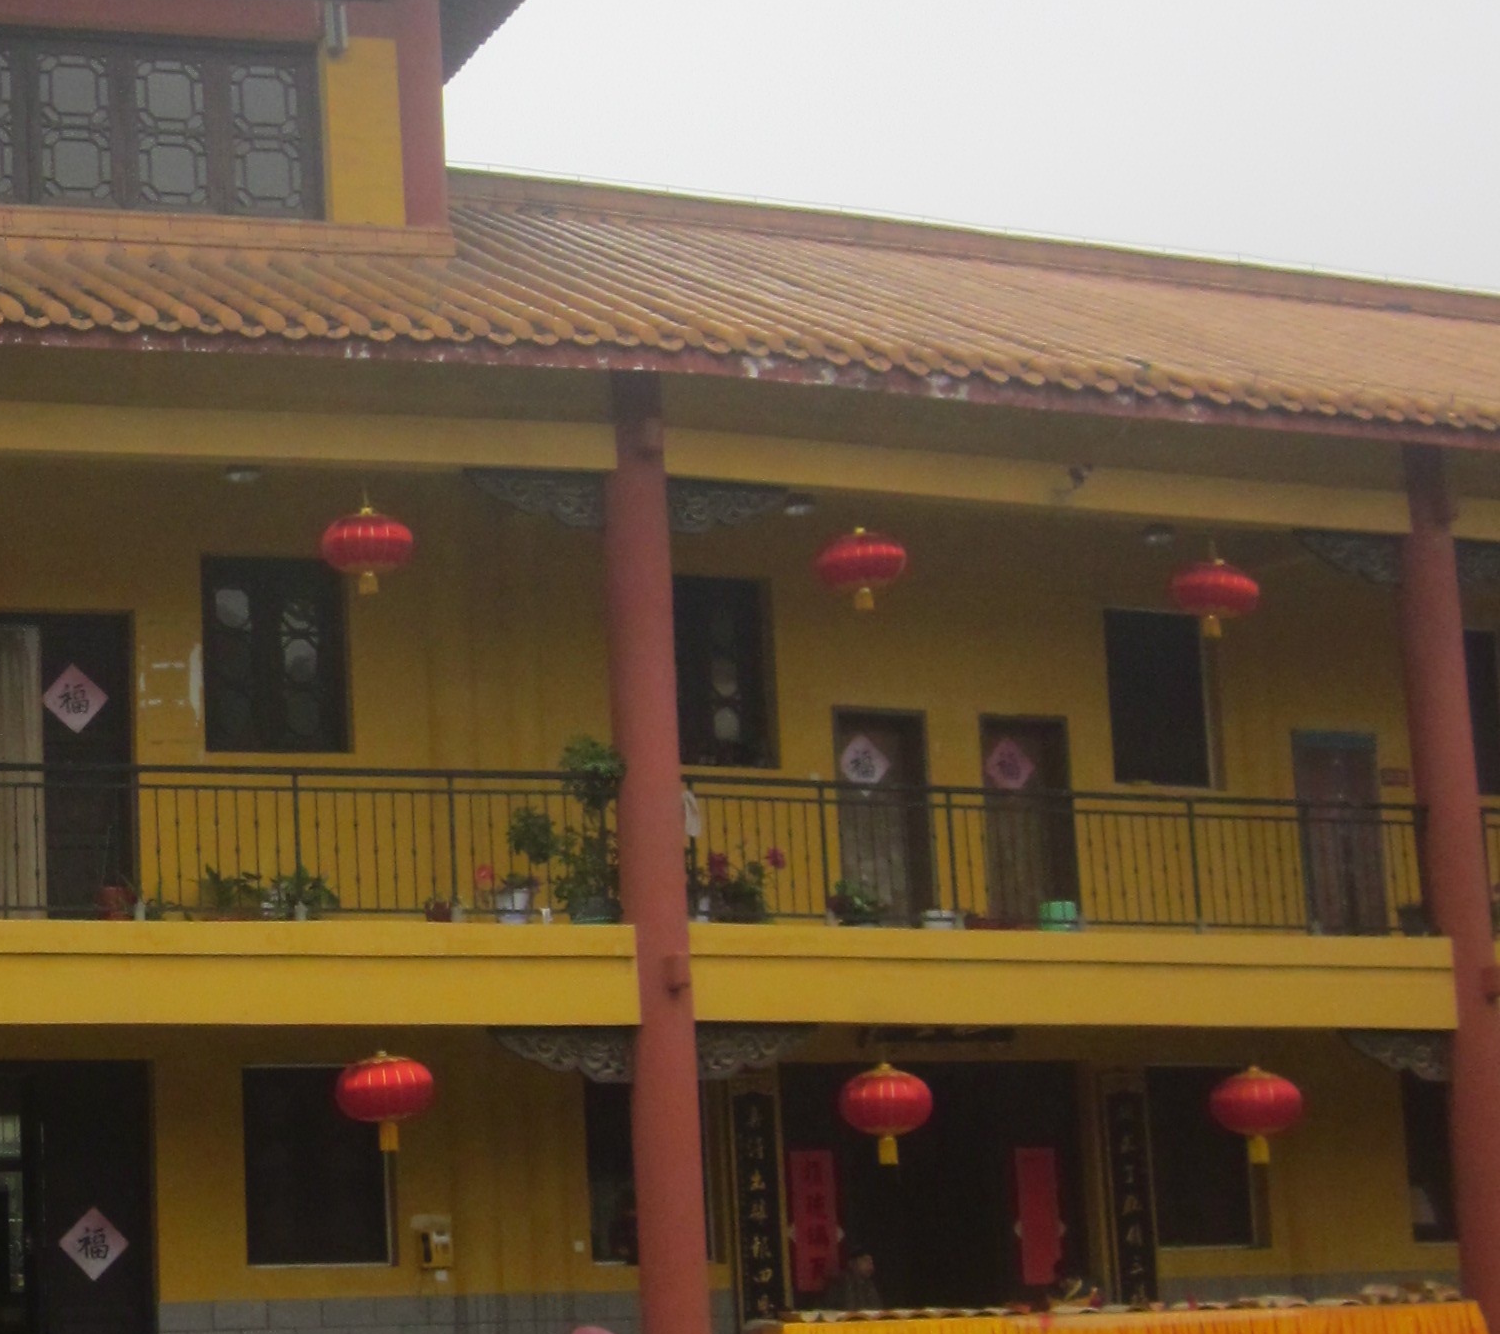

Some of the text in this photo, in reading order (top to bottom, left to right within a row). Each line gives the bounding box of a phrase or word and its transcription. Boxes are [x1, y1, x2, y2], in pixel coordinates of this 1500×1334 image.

[58, 683, 90, 714] 福
[849, 750, 876, 779] 福
[77, 1227, 109, 1259] 福
